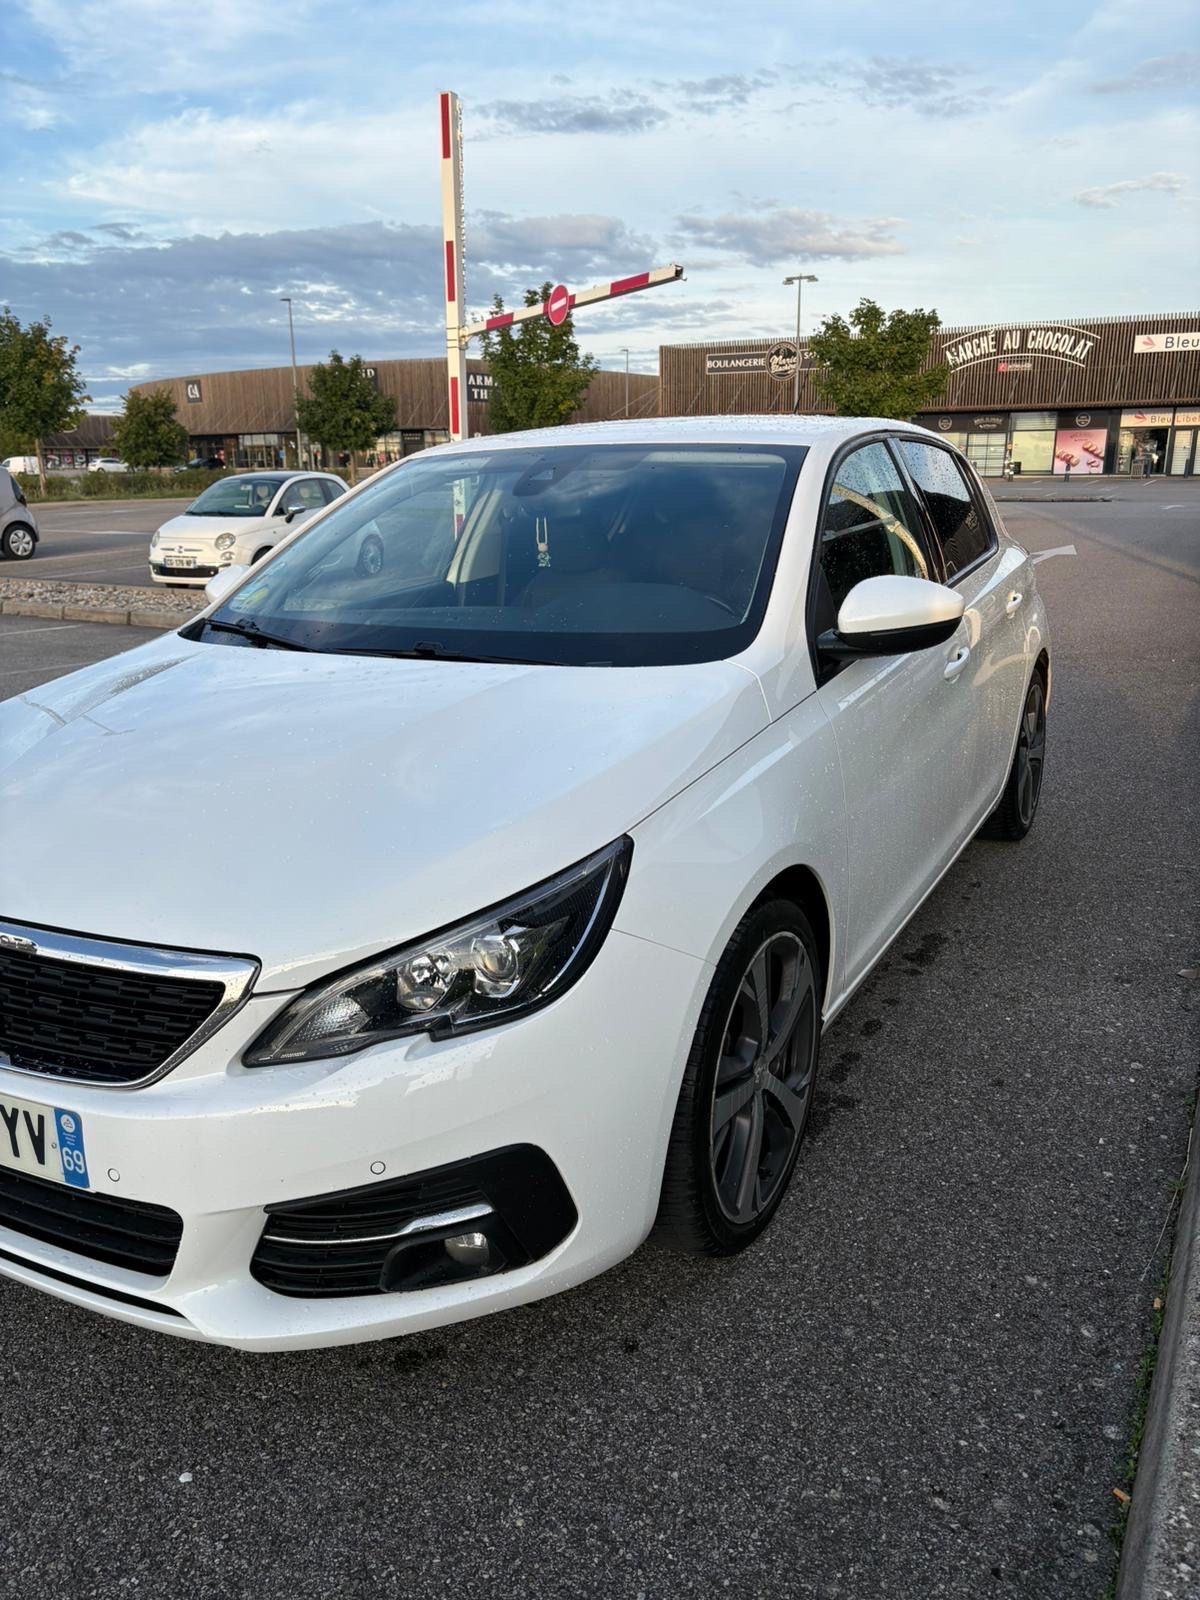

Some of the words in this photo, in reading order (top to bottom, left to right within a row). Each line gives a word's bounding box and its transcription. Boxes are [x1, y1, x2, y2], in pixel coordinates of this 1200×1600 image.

[1003, 330, 1020, 351] AU
[1027, 329, 1094, 361] CHOCOLAT
[1165, 336, 1200, 349] Bleu
[706, 358, 766, 369] BOULANGERIE
[468, 374, 498, 387] ARM
[1150, 415, 1172, 423] Bleu
[62, 1147, 86, 1174] 69
